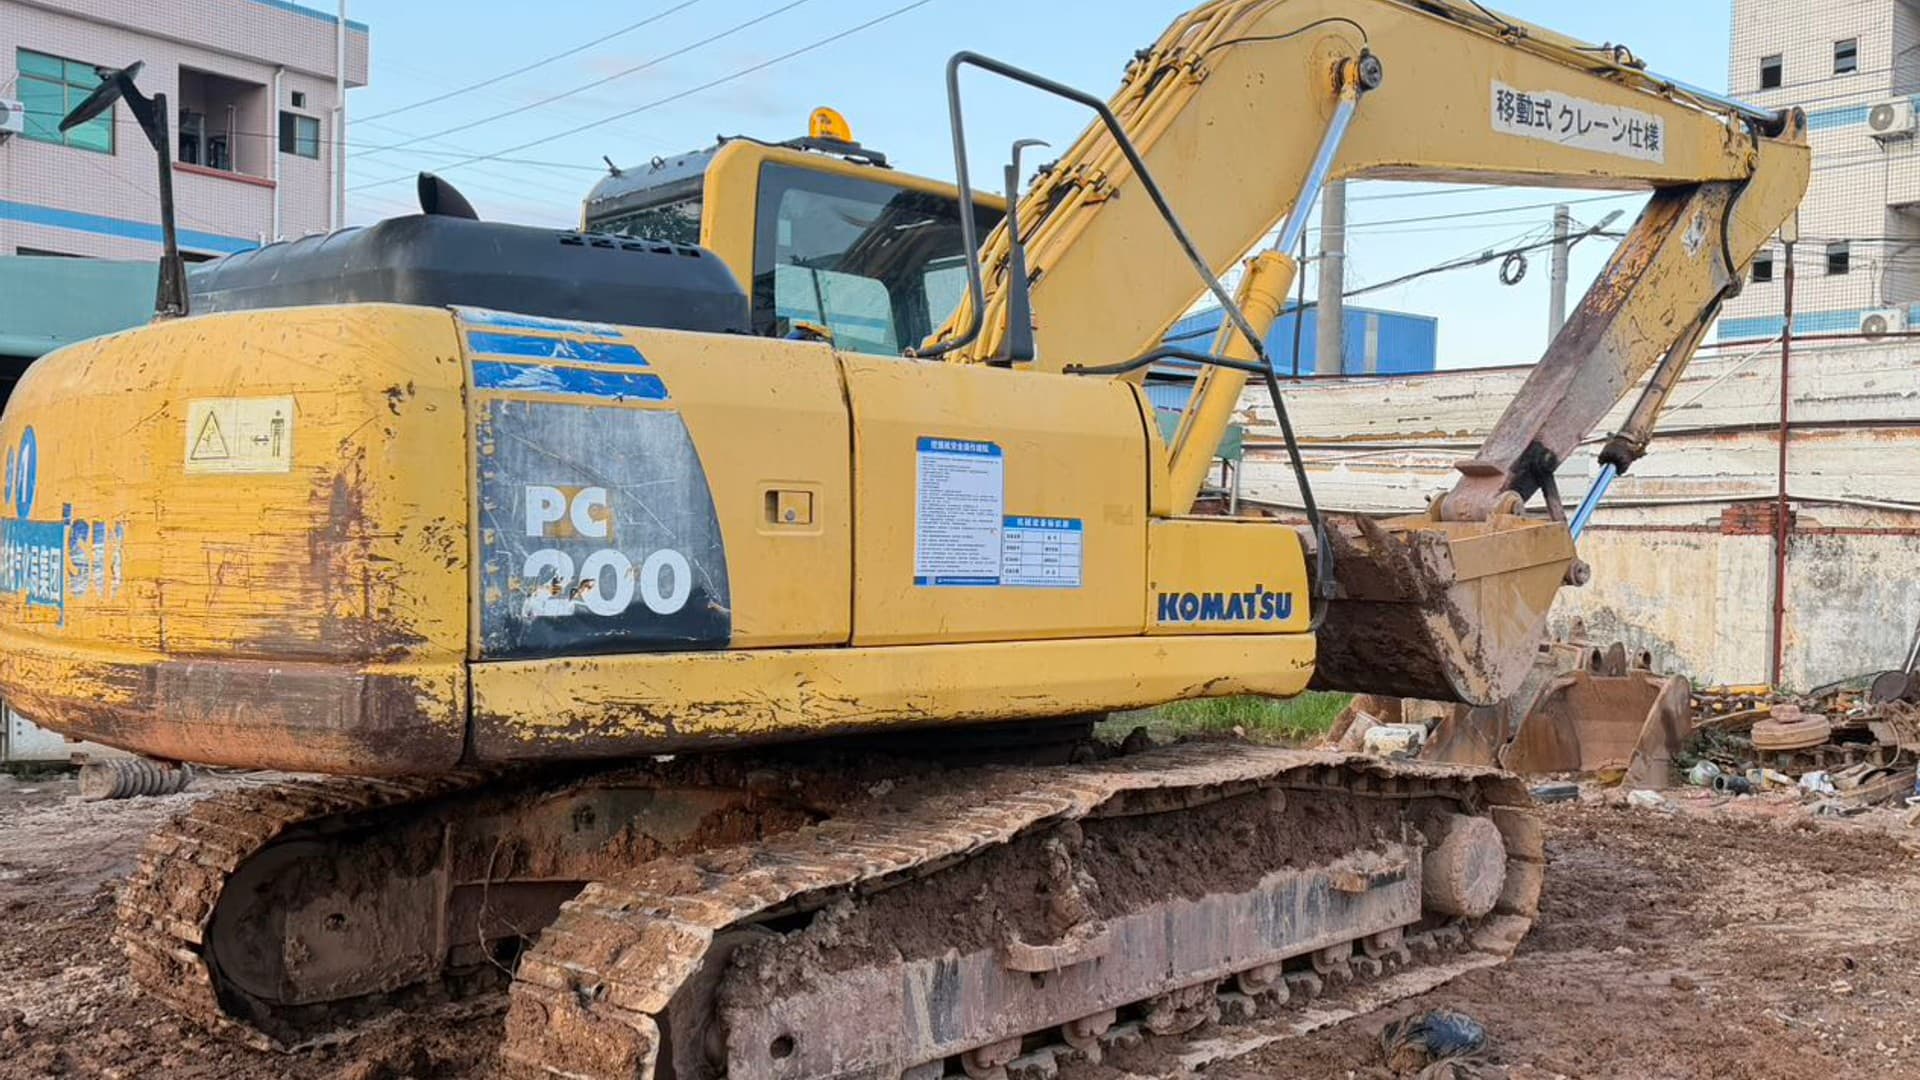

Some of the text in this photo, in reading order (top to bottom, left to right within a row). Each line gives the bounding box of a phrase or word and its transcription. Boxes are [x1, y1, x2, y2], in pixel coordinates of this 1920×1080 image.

[525, 486, 607, 538] PC
[523, 548, 692, 616] 200
[1158, 584, 1292, 621] KOMATSU
